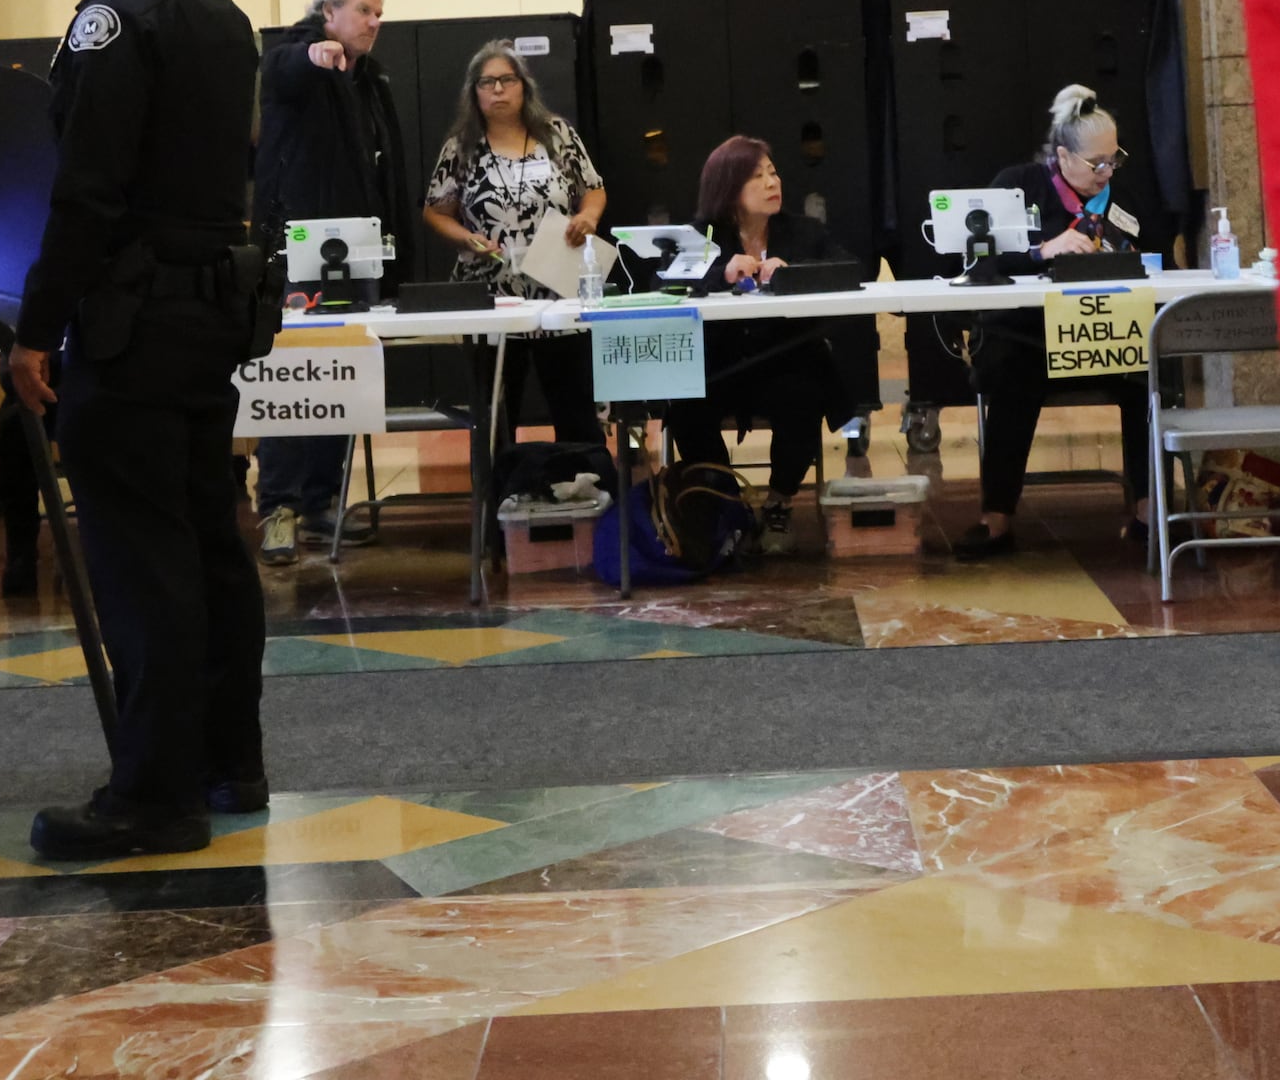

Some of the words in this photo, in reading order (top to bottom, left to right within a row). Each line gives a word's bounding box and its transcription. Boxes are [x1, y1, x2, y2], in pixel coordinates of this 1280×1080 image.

[936, 196, 949, 211] 10
[293, 228, 307, 241] 10
[1079, 295, 1112, 316] SE
[1058, 320, 1143, 343] HABLA
[601, 331, 695, 365] 講國語
[1048, 346, 1149, 371] ESPANOL
[239, 359, 356, 382] Check-in
[250, 397, 345, 420] Station
